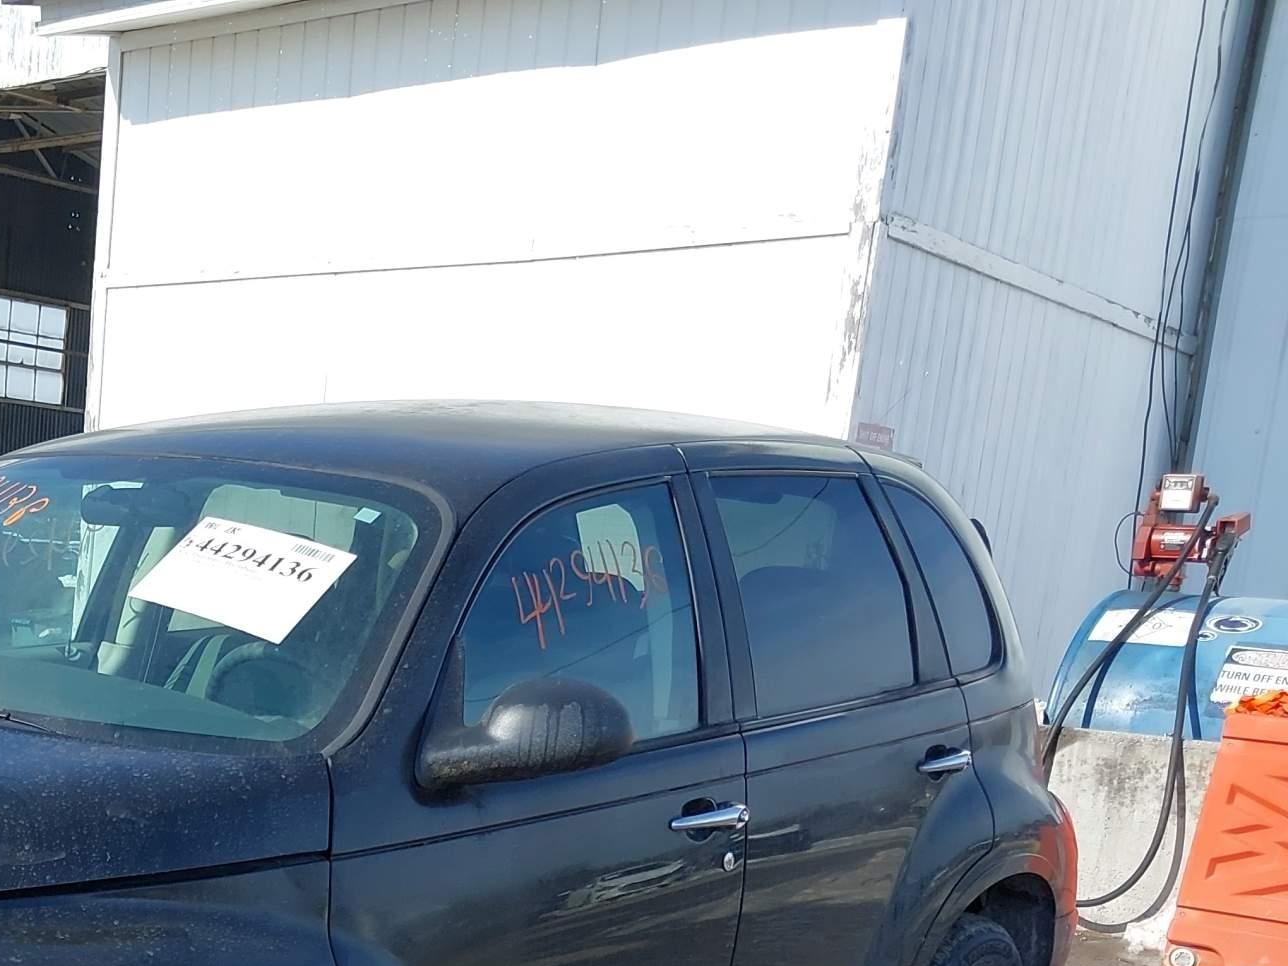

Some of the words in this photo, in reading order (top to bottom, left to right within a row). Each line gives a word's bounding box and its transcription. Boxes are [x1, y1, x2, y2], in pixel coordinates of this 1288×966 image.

[195, 538, 319, 583] 44294136
[1221, 671, 1251, 681] TURN
[1253, 674, 1273, 683] OFF
[1275, 676, 1288, 686] EN
[1216, 684, 1250, 697] WHILE
